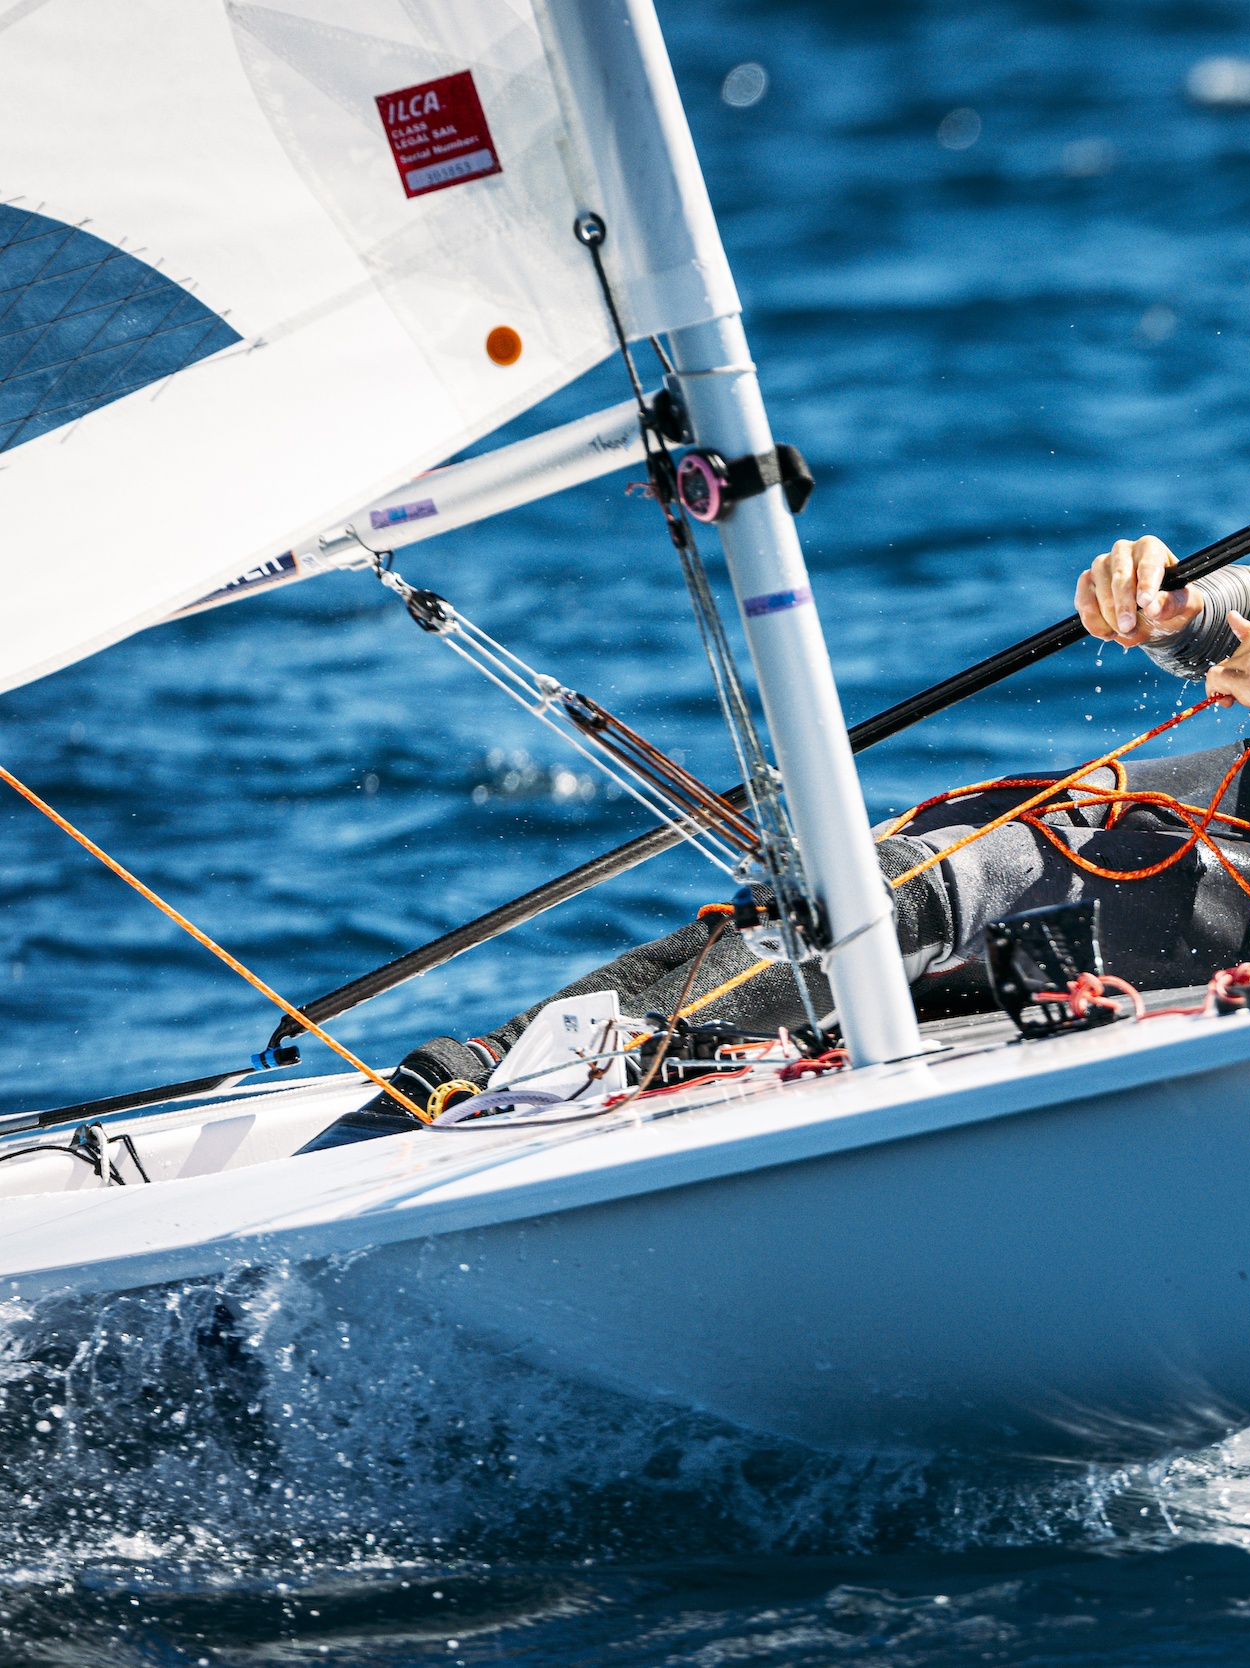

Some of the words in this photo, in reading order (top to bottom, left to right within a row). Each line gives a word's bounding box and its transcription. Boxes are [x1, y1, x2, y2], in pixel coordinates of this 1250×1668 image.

[388, 91, 440, 125] ILCA
[391, 122, 428, 139] CLASS
[395, 133, 430, 150] LEGAL
[431, 125, 457, 139] SAIL
